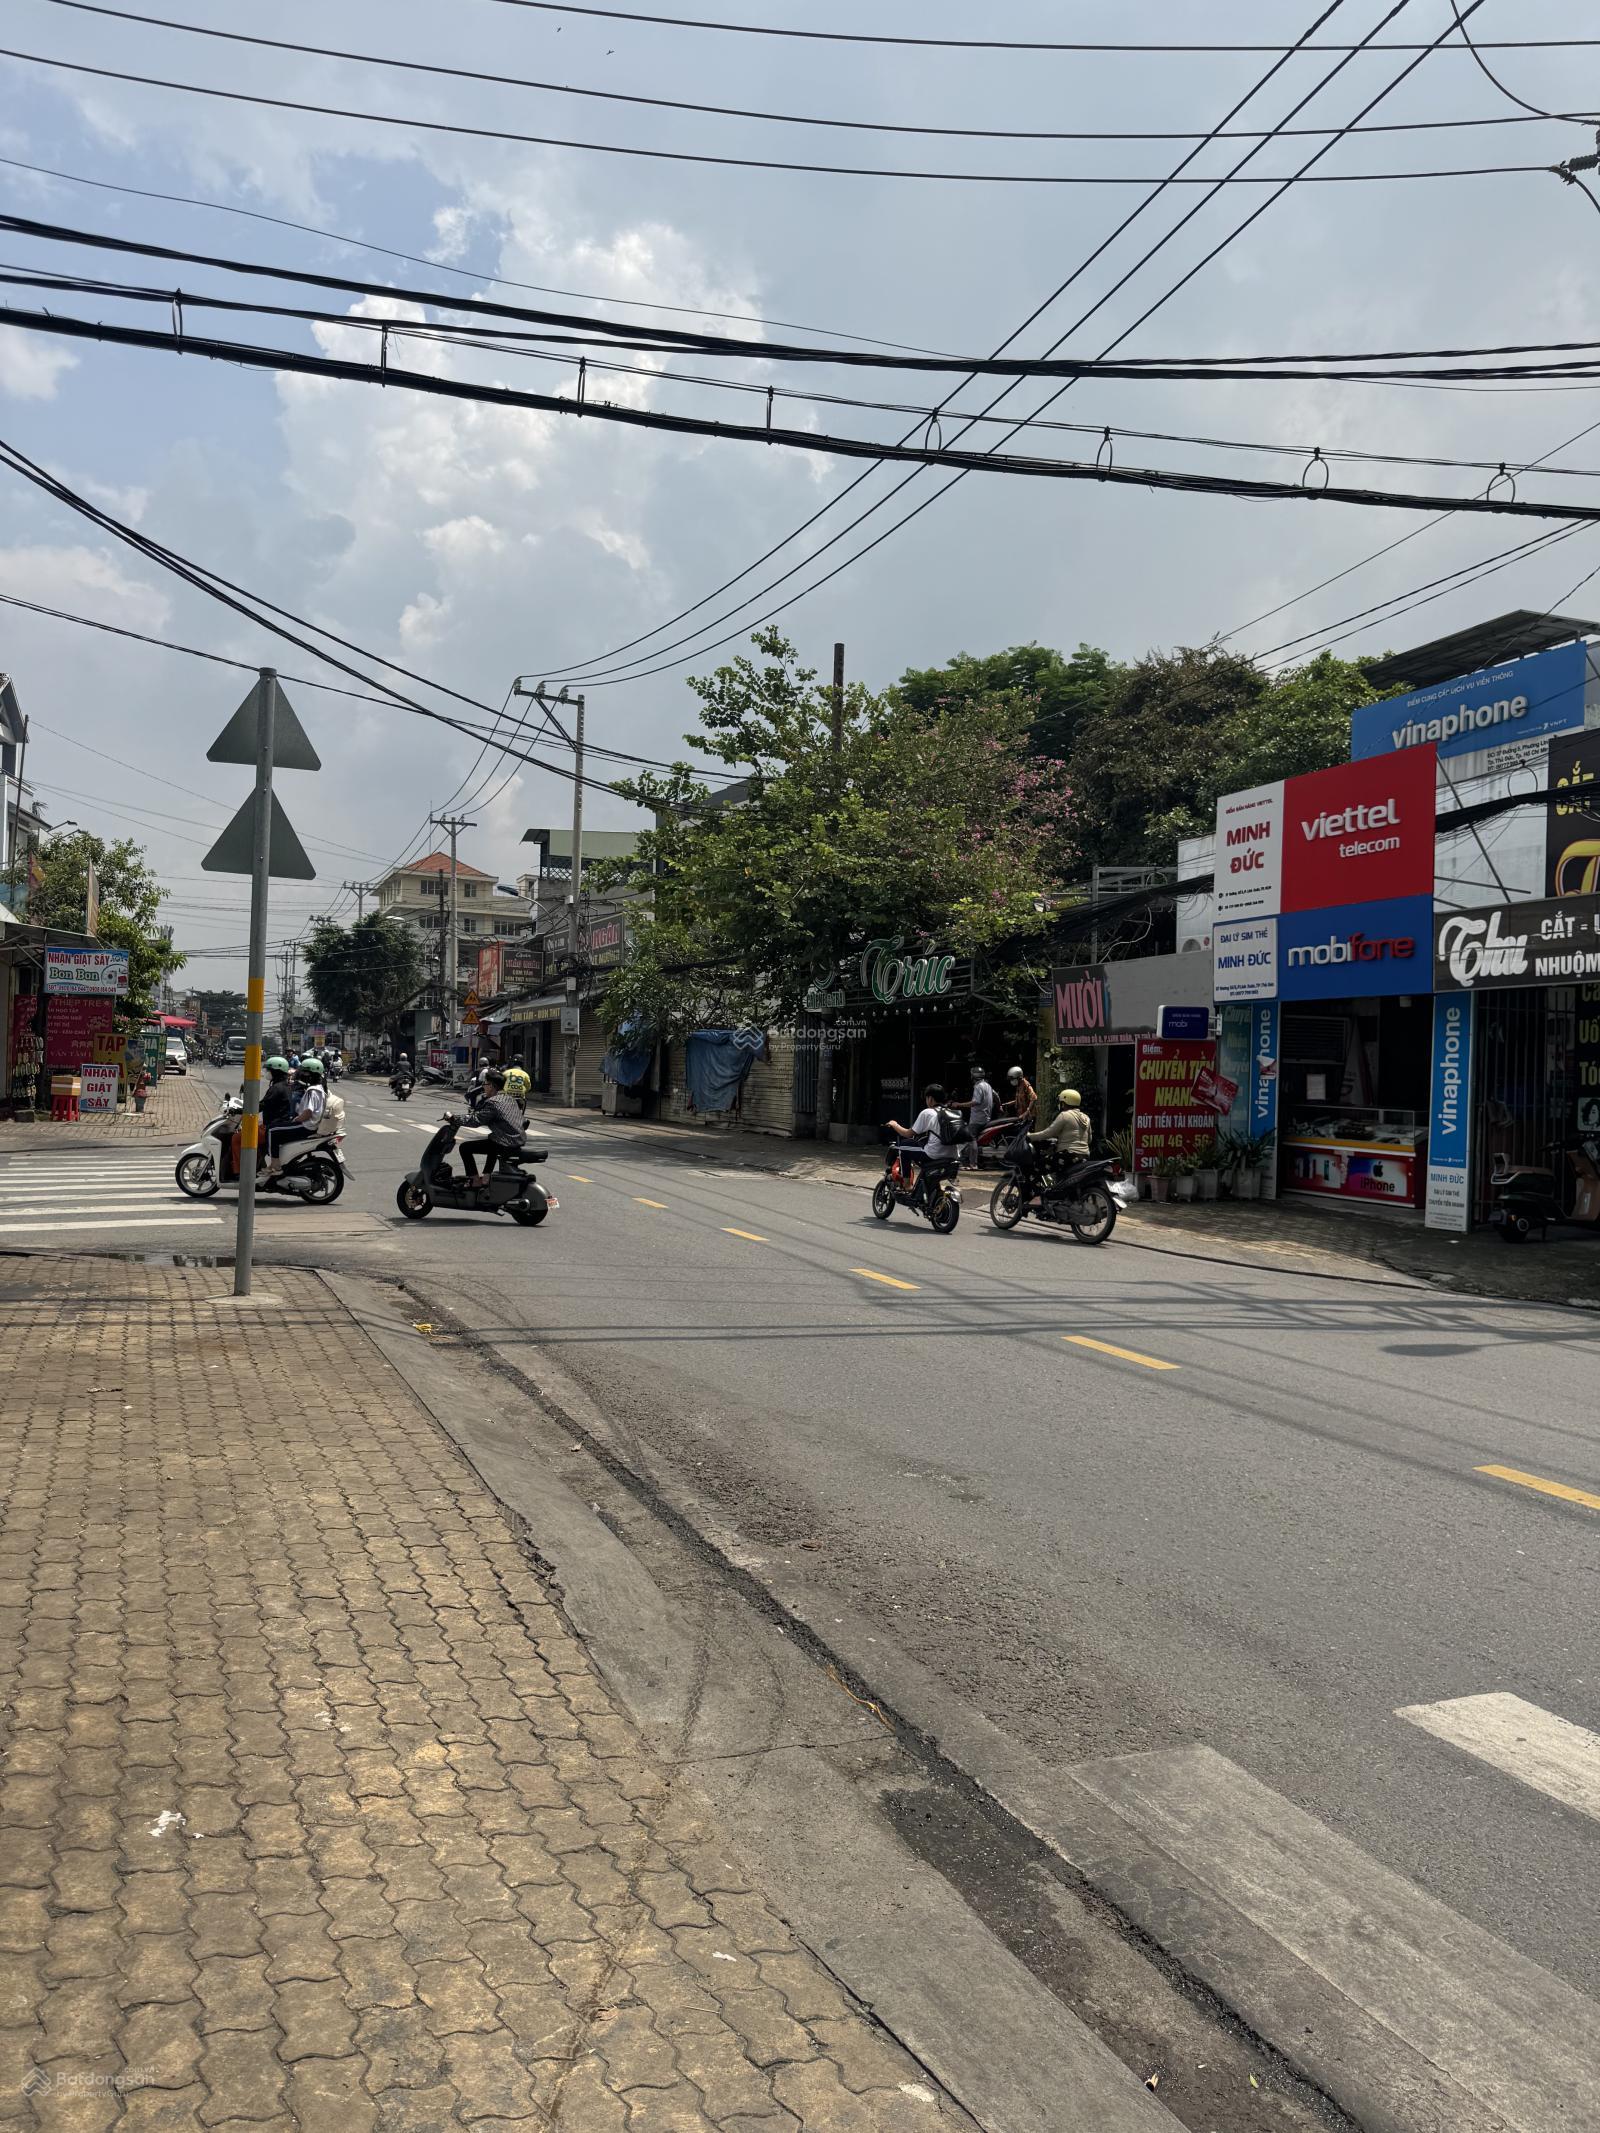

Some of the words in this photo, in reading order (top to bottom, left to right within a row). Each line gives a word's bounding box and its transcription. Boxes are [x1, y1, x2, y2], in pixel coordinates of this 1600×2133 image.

[1421, 694, 1437, 704] CUNG
[1392, 696, 1528, 749] vinaphone
[1301, 798, 1401, 841] viettel
[1227, 821, 1270, 847] MINH
[1339, 836, 1400, 858] telecom
[1230, 848, 1264, 874] ĐỨC
[1241, 931, 1253, 941] SIM
[48, 951, 71, 966] NHẬN
[73, 952, 92, 967] GIẶT
[1288, 932, 1415, 967] mobifone
[1218, 954, 1245, 970] MINH
[1248, 949, 1271, 966] ĐỨC
[1535, 950, 1600, 978] NHUỘM
[50, 967, 74, 980] Bon
[76, 968, 100, 982] Bon
[861, 935, 956, 1004] Trúc
[1056, 970, 1105, 1029] MƯỜI
[97, 1035, 126, 1055] TẠP
[1143, 1043, 1163, 1055] Điểm:
[84, 1065, 117, 1080] NHẬN
[1139, 1049, 1186, 1081] CHUYỂN
[1438, 1007, 1461, 1135] vinaphone
[509, 1072, 523, 1084] be
[86, 1081, 113, 1095] GIẶT
[87, 1094, 110, 1107] SẤY
[1137, 1113, 1152, 1128] RÚT
[1174, 1112, 1186, 1128] TÀI
[1187, 1110, 1215, 1128] KHOẢN
[1141, 1134, 1164, 1148] SIM
[1167, 1134, 1183, 1148] 4G
[1361, 1176, 1396, 1192] iPhone
[1431, 1173, 1448, 1183] MINH
